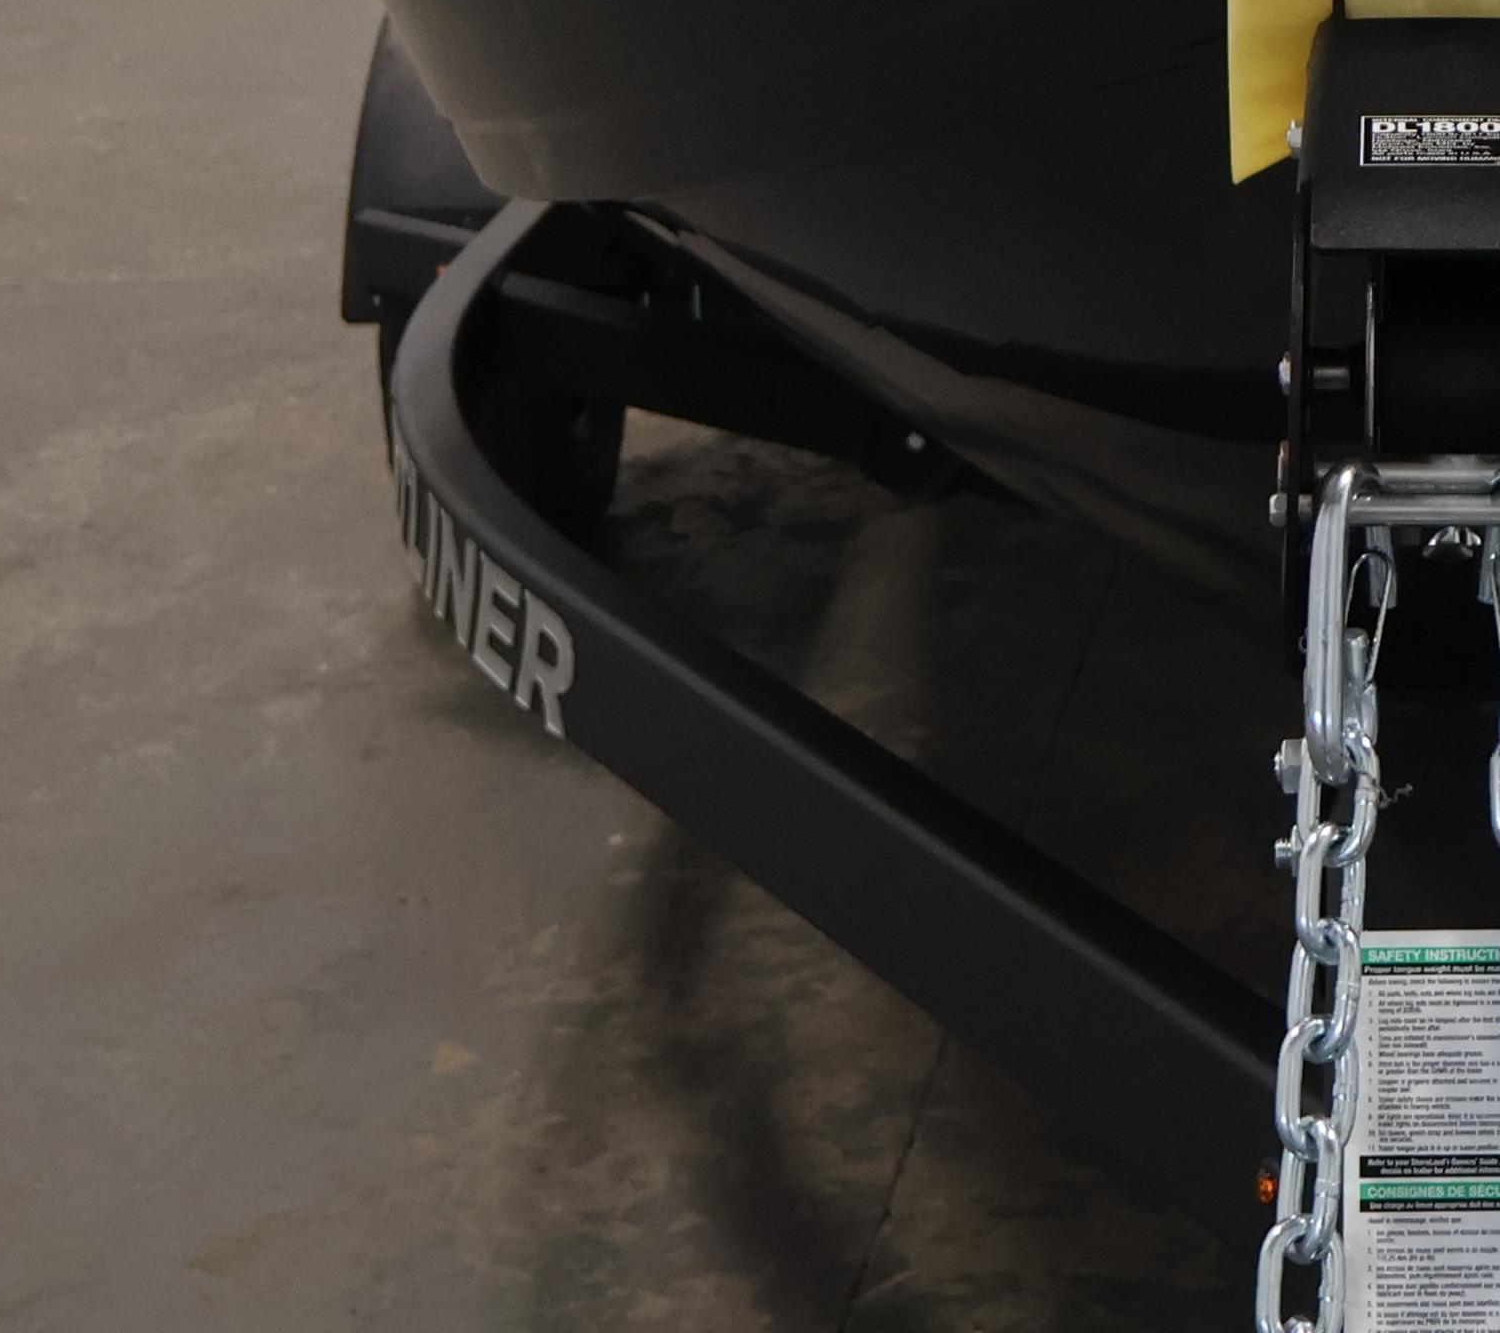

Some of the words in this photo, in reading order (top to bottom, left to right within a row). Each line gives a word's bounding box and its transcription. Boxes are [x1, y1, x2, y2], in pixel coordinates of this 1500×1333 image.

[1368, 948, 1422, 962] SAFETY
[1368, 1185, 1444, 1199] CONSIGNES
[1447, 1185, 1465, 1199] DE
